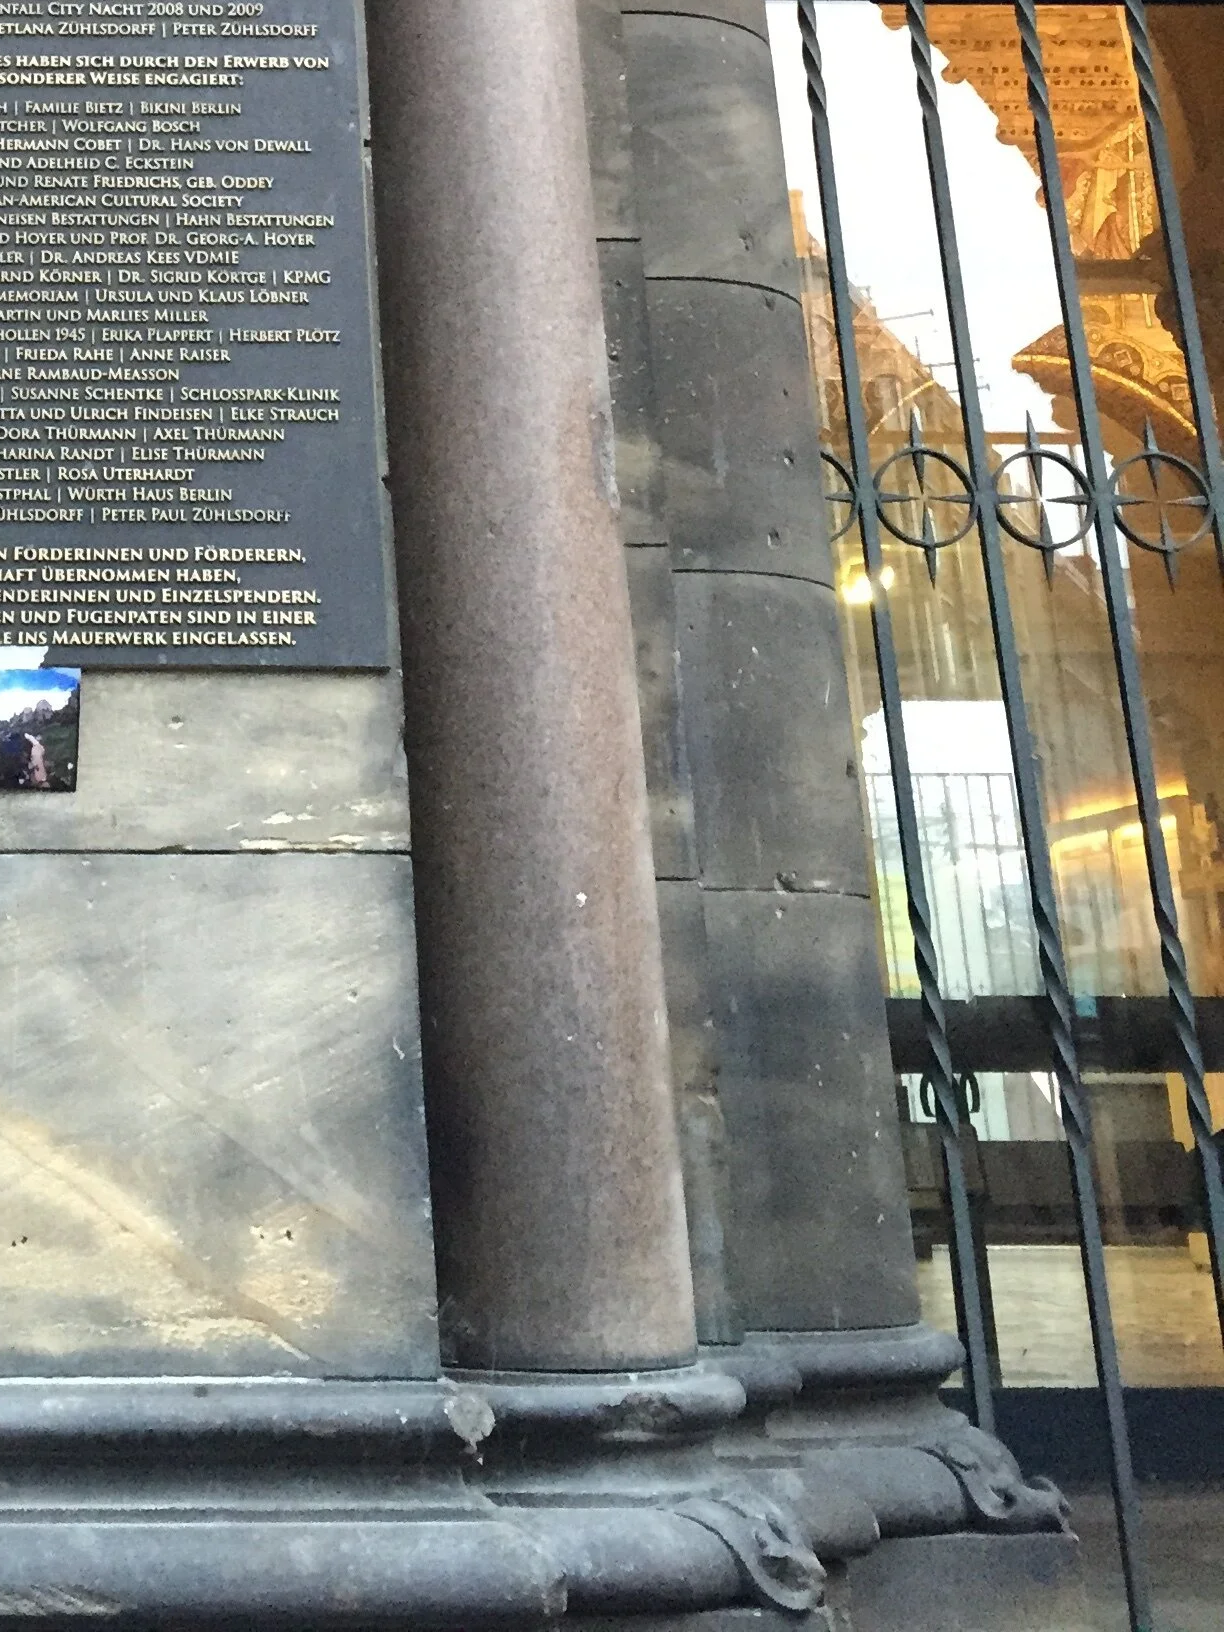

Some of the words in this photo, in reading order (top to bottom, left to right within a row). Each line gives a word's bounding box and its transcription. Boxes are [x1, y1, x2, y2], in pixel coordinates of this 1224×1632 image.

[15, 55, 73, 68] HABEN
[75, 55, 116, 68] SICH
[119, 55, 180, 68] DURCH
[184, 55, 219, 68] DEN
[223, 54, 290, 69] ERWERB
[291, 56, 329, 69] VON
[89, 71, 141, 85] WEISE
[148, 547, 189, 562] UND
[115, 589, 156, 603] UND
[20, 610, 62, 624] UND
[66, 608, 182, 624] FUGENPATEN
[186, 609, 232, 624] SIND
[236, 610, 257, 625] IN
[262, 610, 317, 625] EINER
[18, 631, 48, 645] INS
[51, 630, 168, 646] MAUERWERK
